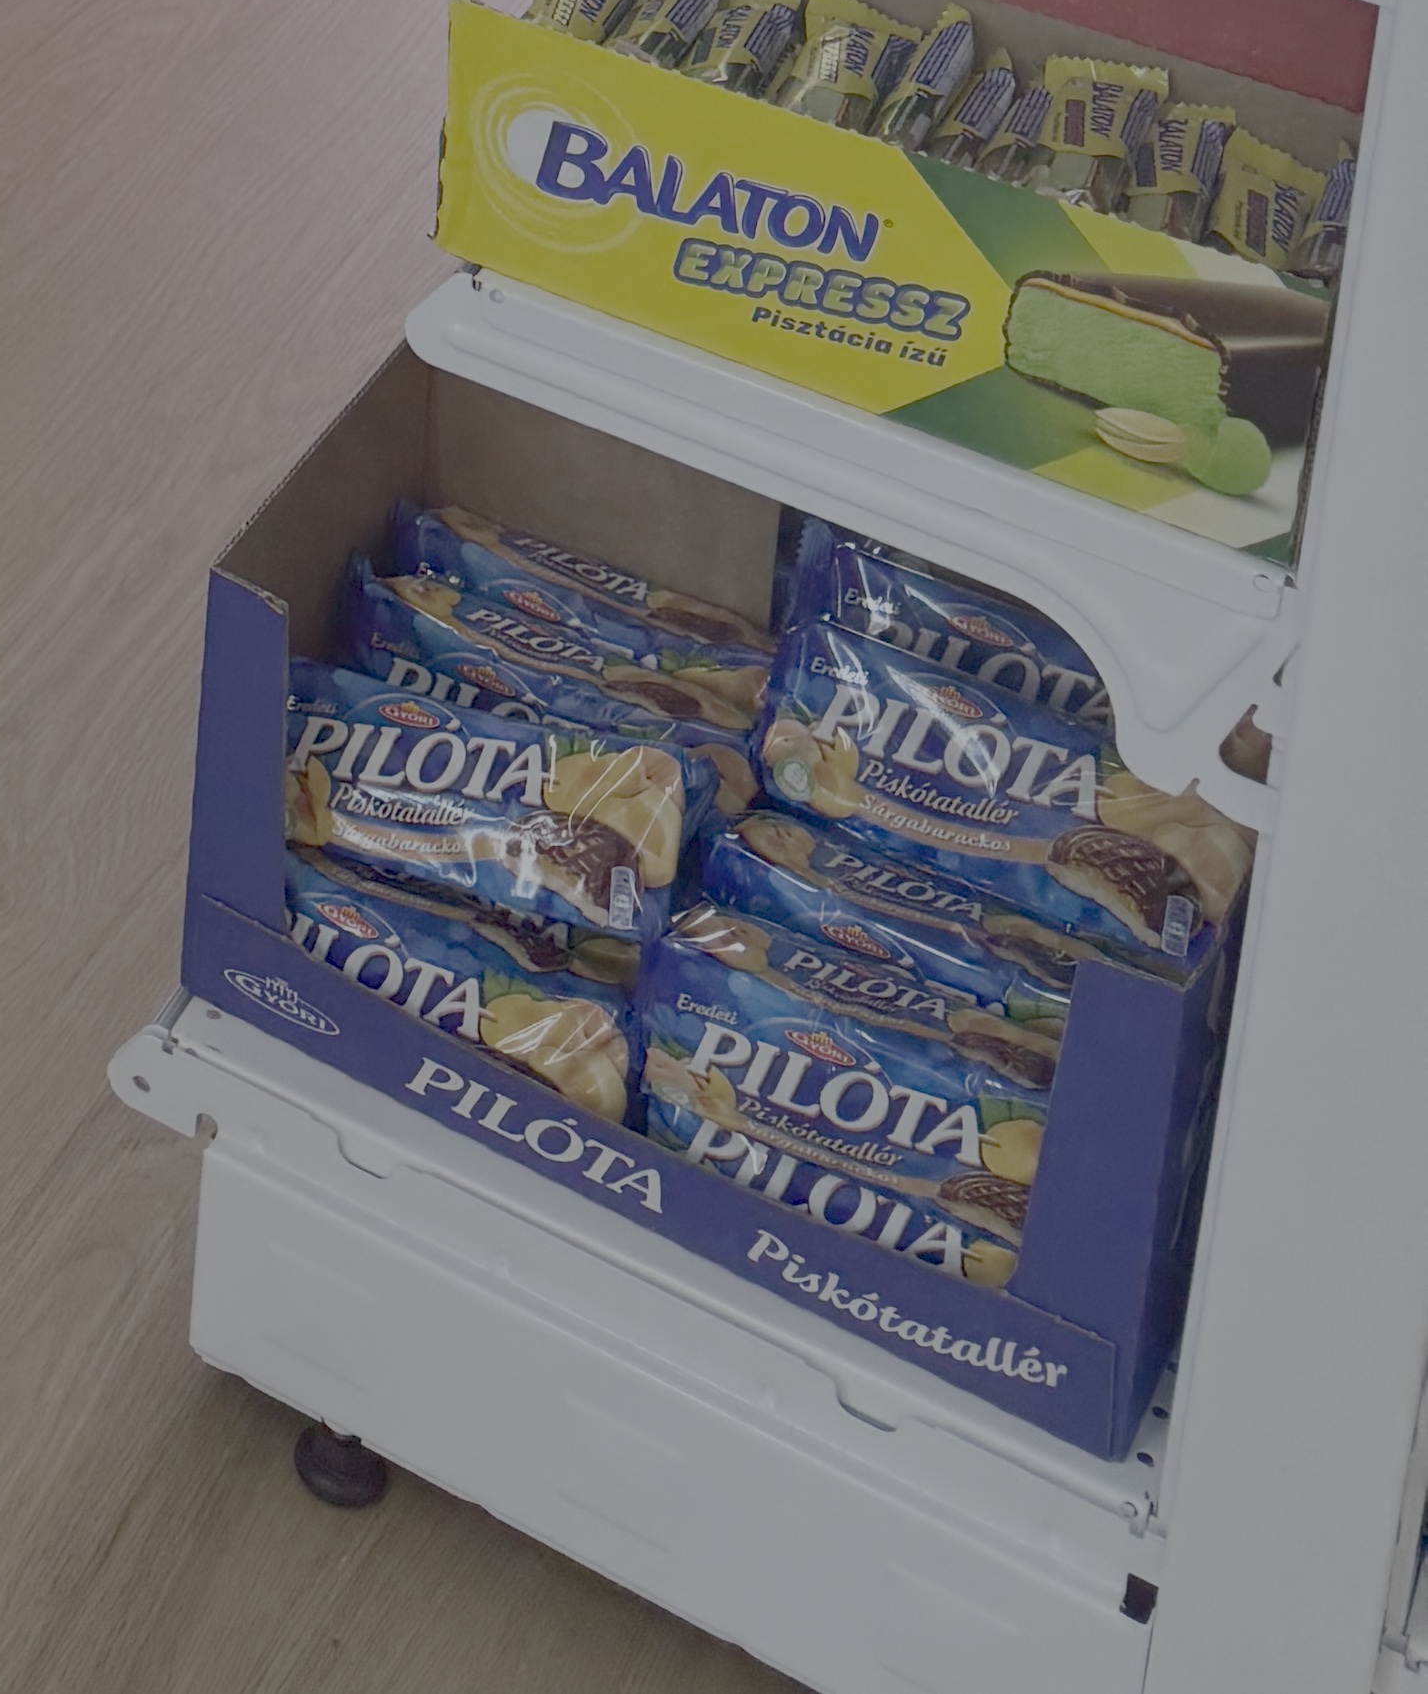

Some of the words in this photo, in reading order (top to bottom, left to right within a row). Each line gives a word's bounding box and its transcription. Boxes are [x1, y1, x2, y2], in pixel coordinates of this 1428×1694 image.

[535, 119, 882, 260] BALATON
[673, 236, 974, 343] EXPRESSZ
[750, 304, 894, 356] Pisztácia
[897, 336, 948, 369] ízű
[511, 536, 649, 602] PILÓTA
[465, 607, 606, 674] PILÓTA
[289, 715, 550, 808] PILÓTA
[811, 685, 1101, 819] PILÓTA
[859, 757, 1020, 826] Piskótatallér
[859, 794, 1012, 854] Sárgabarackos
[825, 851, 984, 918] PILÓTA
[230, 974, 334, 1032] GYŐRI
[676, 993, 739, 1027] Eredeti
[783, 950, 947, 1020] PILÓTA
[689, 1020, 984, 1168] PILÓTA
[405, 1056, 666, 1217] PILÓTA
[744, 1229, 1068, 1391] Piskótatallér
